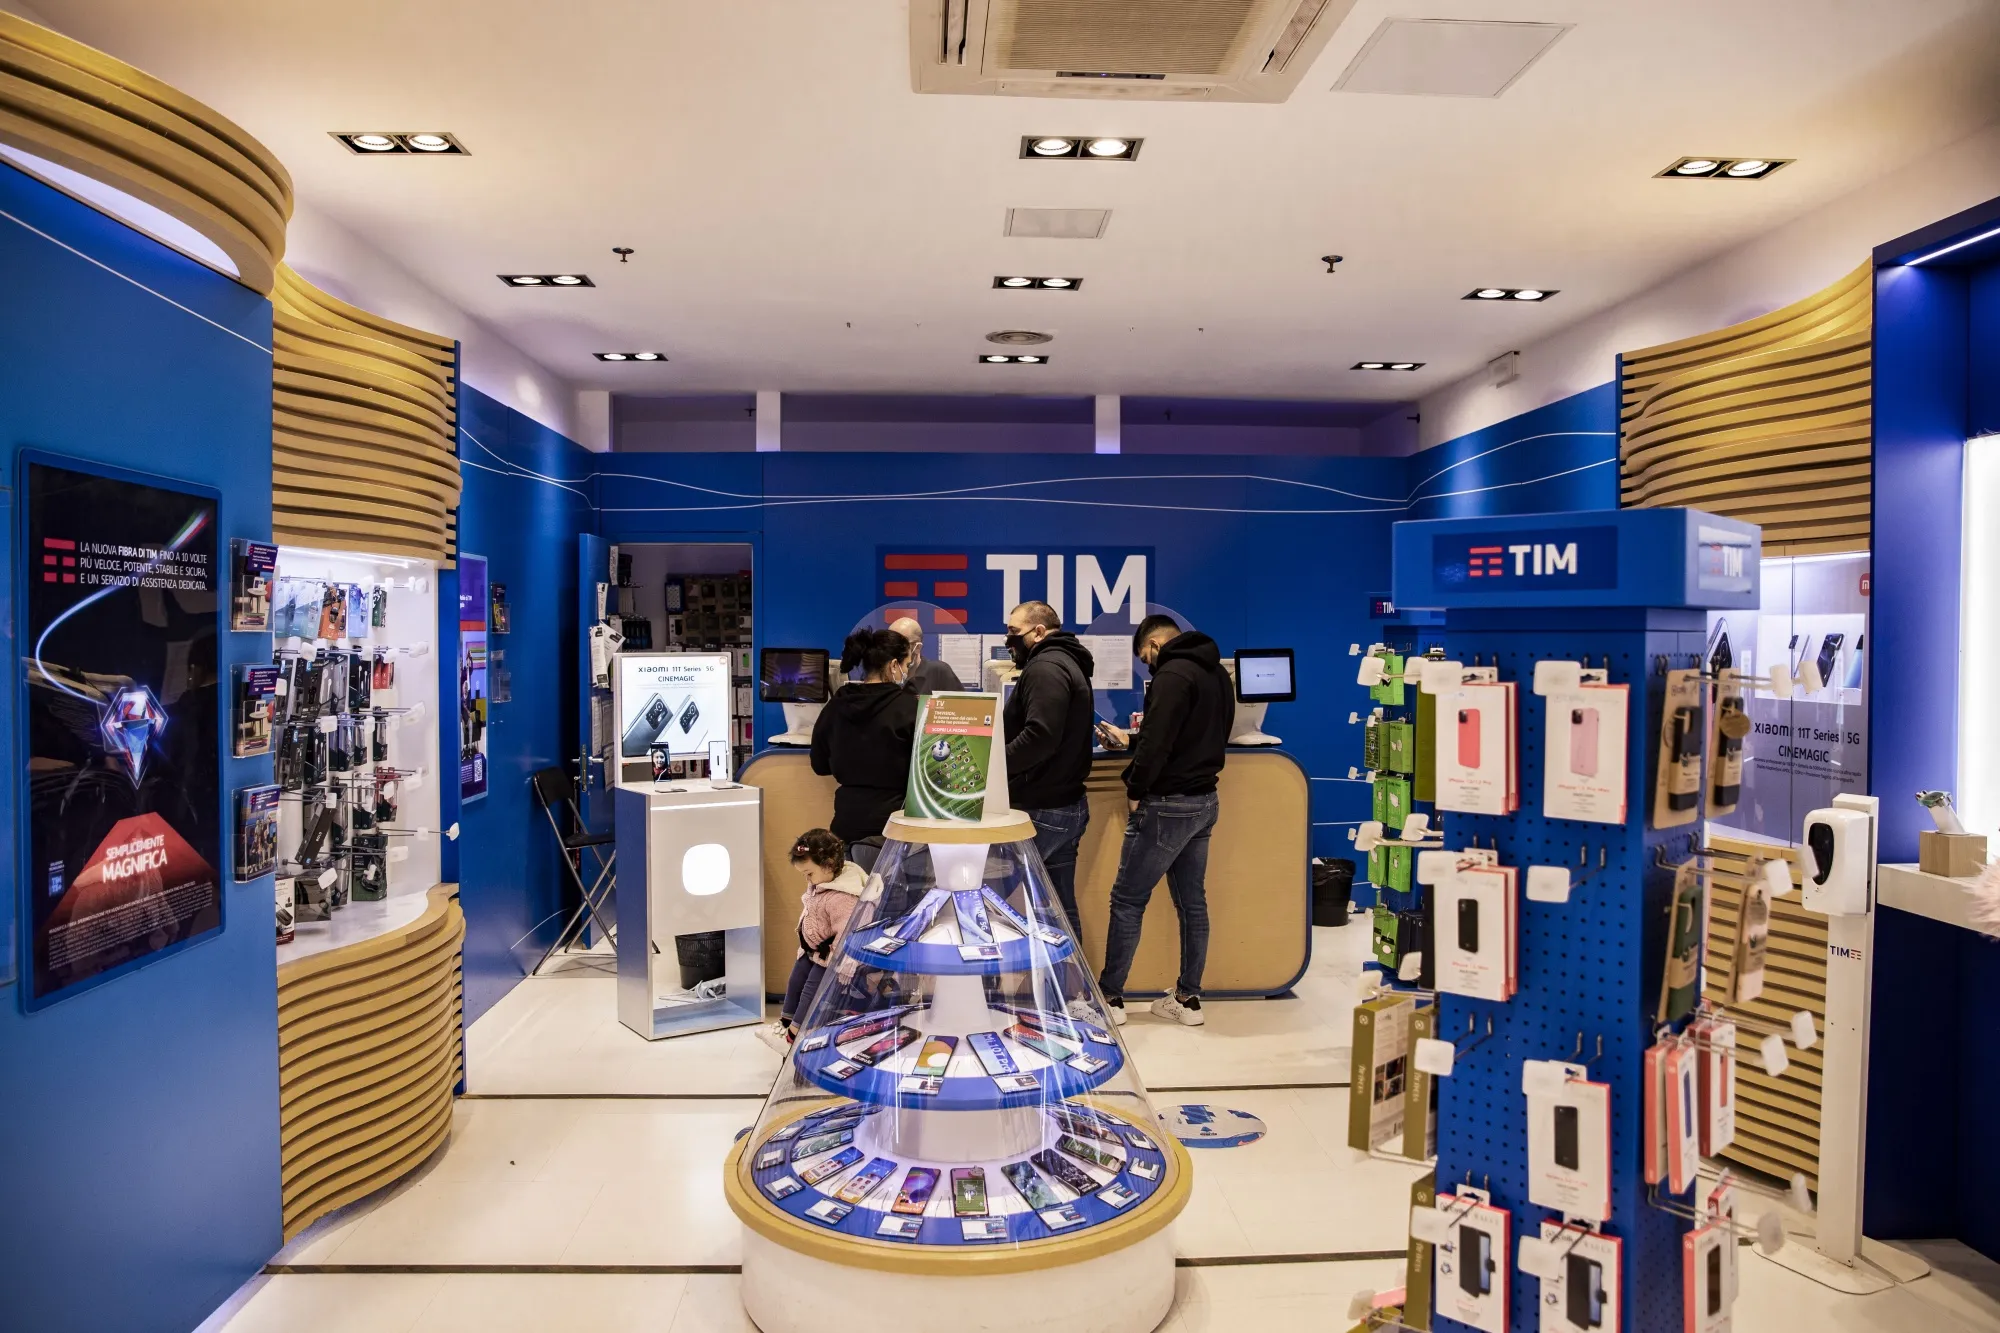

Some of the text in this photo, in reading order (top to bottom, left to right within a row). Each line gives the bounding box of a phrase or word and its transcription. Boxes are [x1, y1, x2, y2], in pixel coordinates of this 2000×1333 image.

[80, 542, 207, 564] LA NUOVA FIBRA DI TIM FINO A 10 VOLTE
[1508, 543, 1577, 576] TIM
[1722, 546, 1743, 577] TIM
[80, 556, 208, 578] PIÙ VELOCE, POTENTE, STABILE E SICURA,
[80, 573, 208, 590] E UN SERVIZIO DI ASSISTENZA DEDICATA.
[986, 554, 1147, 624] TIM
[1382, 602, 1395, 613] TIM
[1797, 727, 1811, 739] 11T
[1813, 728, 1839, 743] Series
[1847, 732, 1860, 745] 5G
[1778, 745, 1830, 763] CINEMAGIC
[106, 834, 164, 860] SEMPLICEMENTE
[102, 848, 168, 883] MAGNIFICA
[1830, 945, 1850, 958] TIM
[984, 1034, 1011, 1073] Mi 10T Pro
